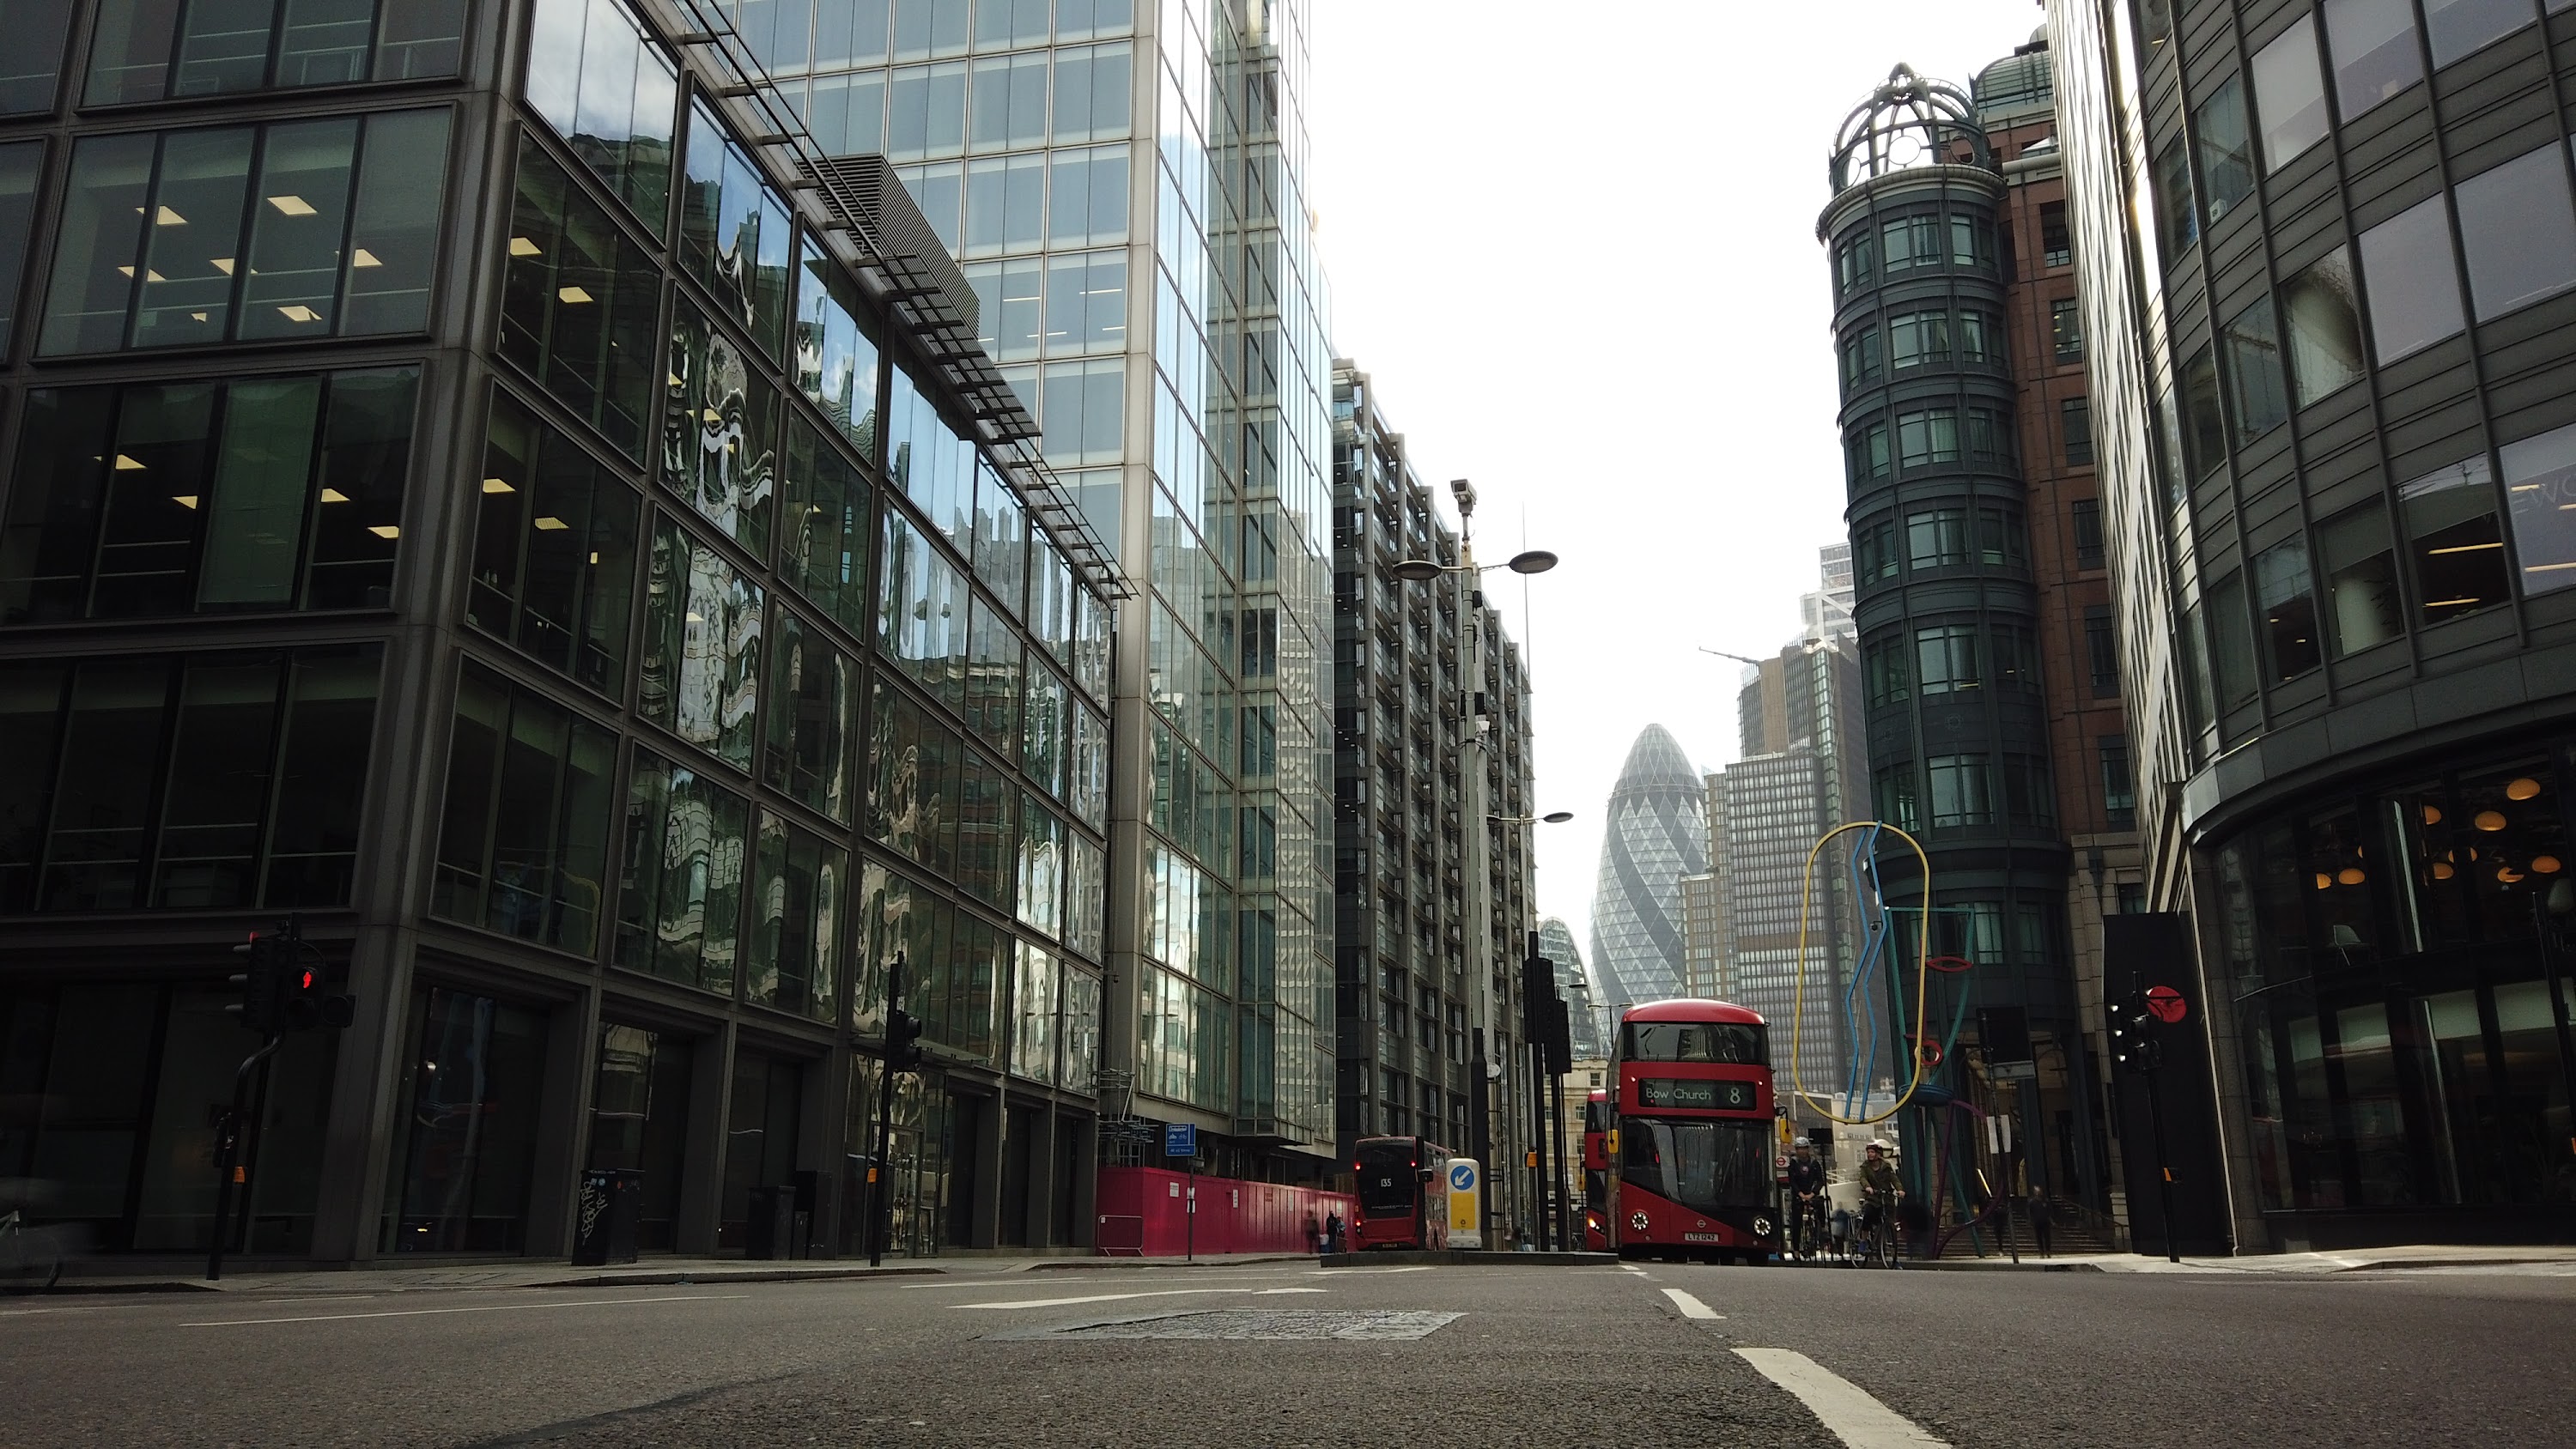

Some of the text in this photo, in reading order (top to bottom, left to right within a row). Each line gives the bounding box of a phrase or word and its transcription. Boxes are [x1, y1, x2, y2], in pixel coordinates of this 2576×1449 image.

[1645, 1087, 1711, 1100] Bow Church
[1729, 1087, 1741, 1104] 8
[1380, 1178, 1392, 1187] 135
